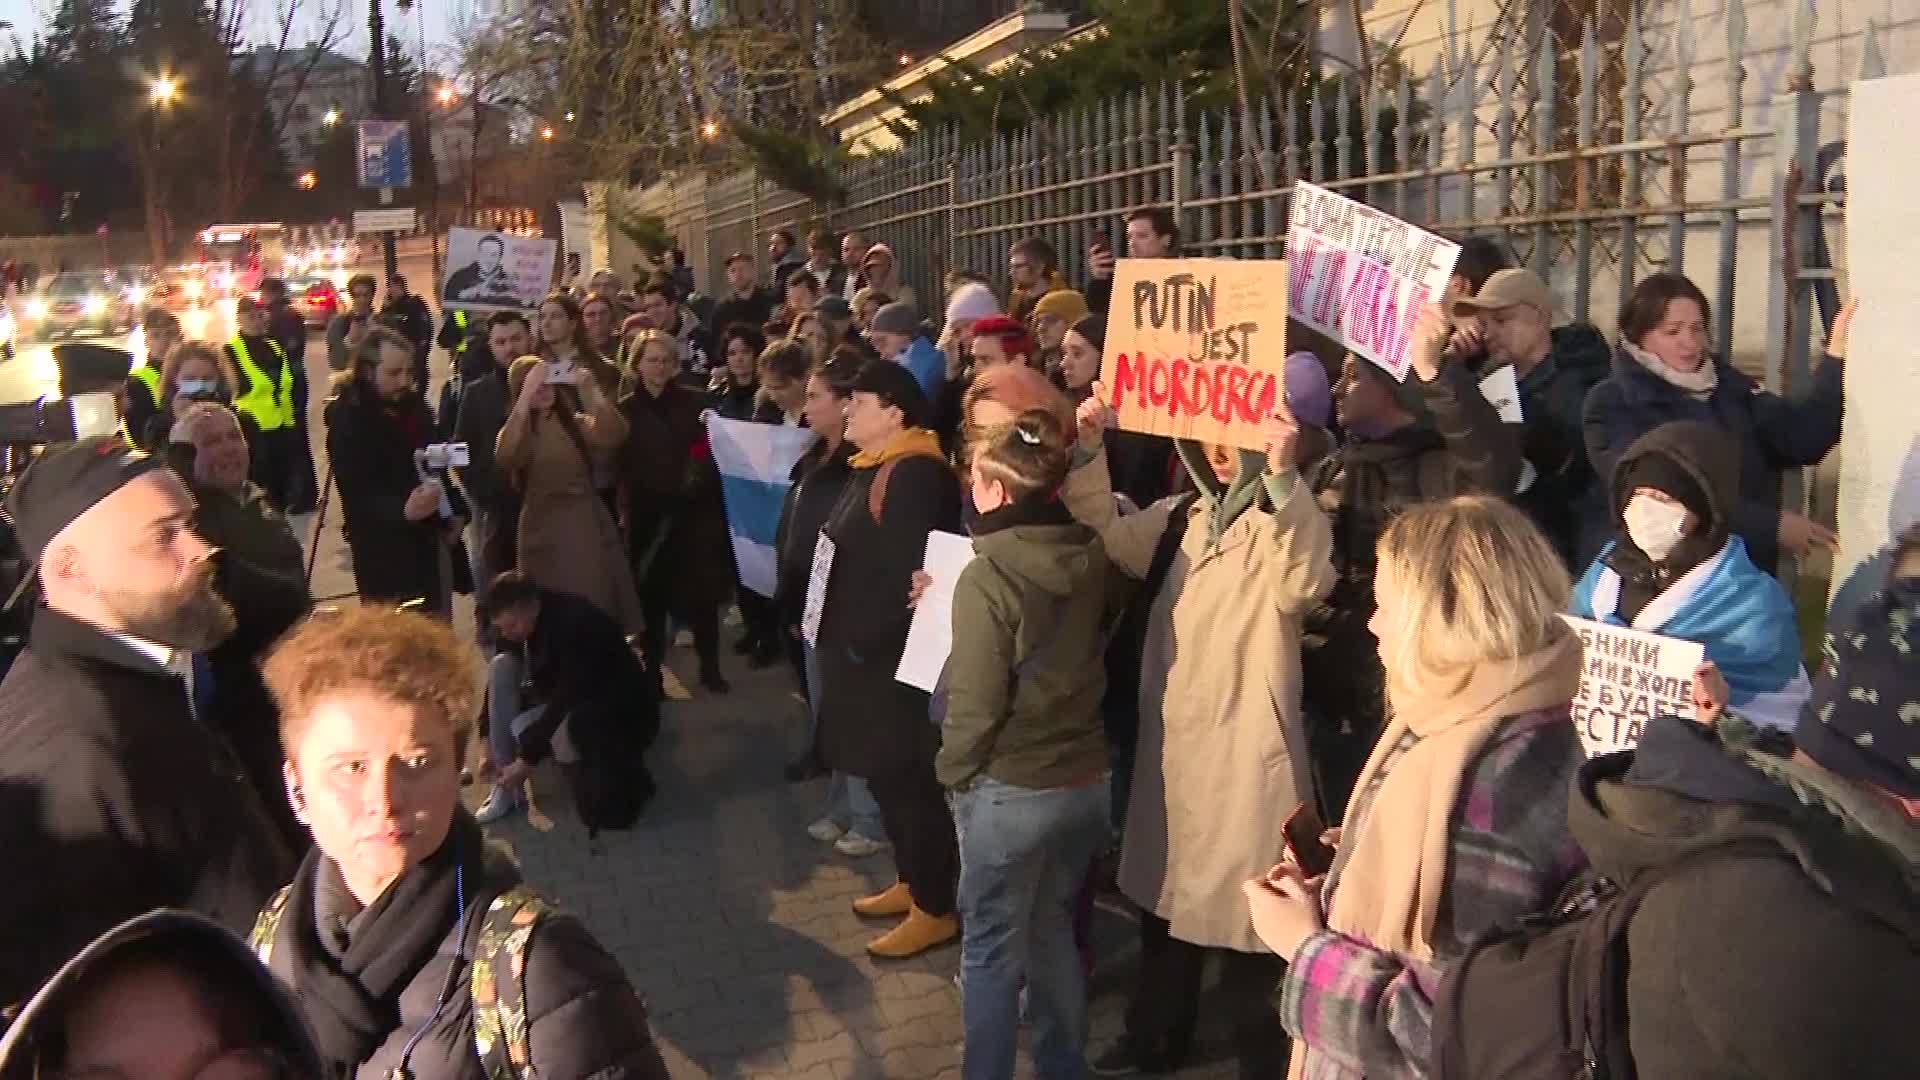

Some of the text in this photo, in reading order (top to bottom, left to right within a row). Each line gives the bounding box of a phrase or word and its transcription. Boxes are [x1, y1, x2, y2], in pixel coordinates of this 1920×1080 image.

[1296, 187, 1452, 289] BOHATEROWIE
[1133, 273, 1217, 335] PUTIN
[1188, 321, 1260, 365] JEST
[1112, 351, 1276, 425] MORDERCA
